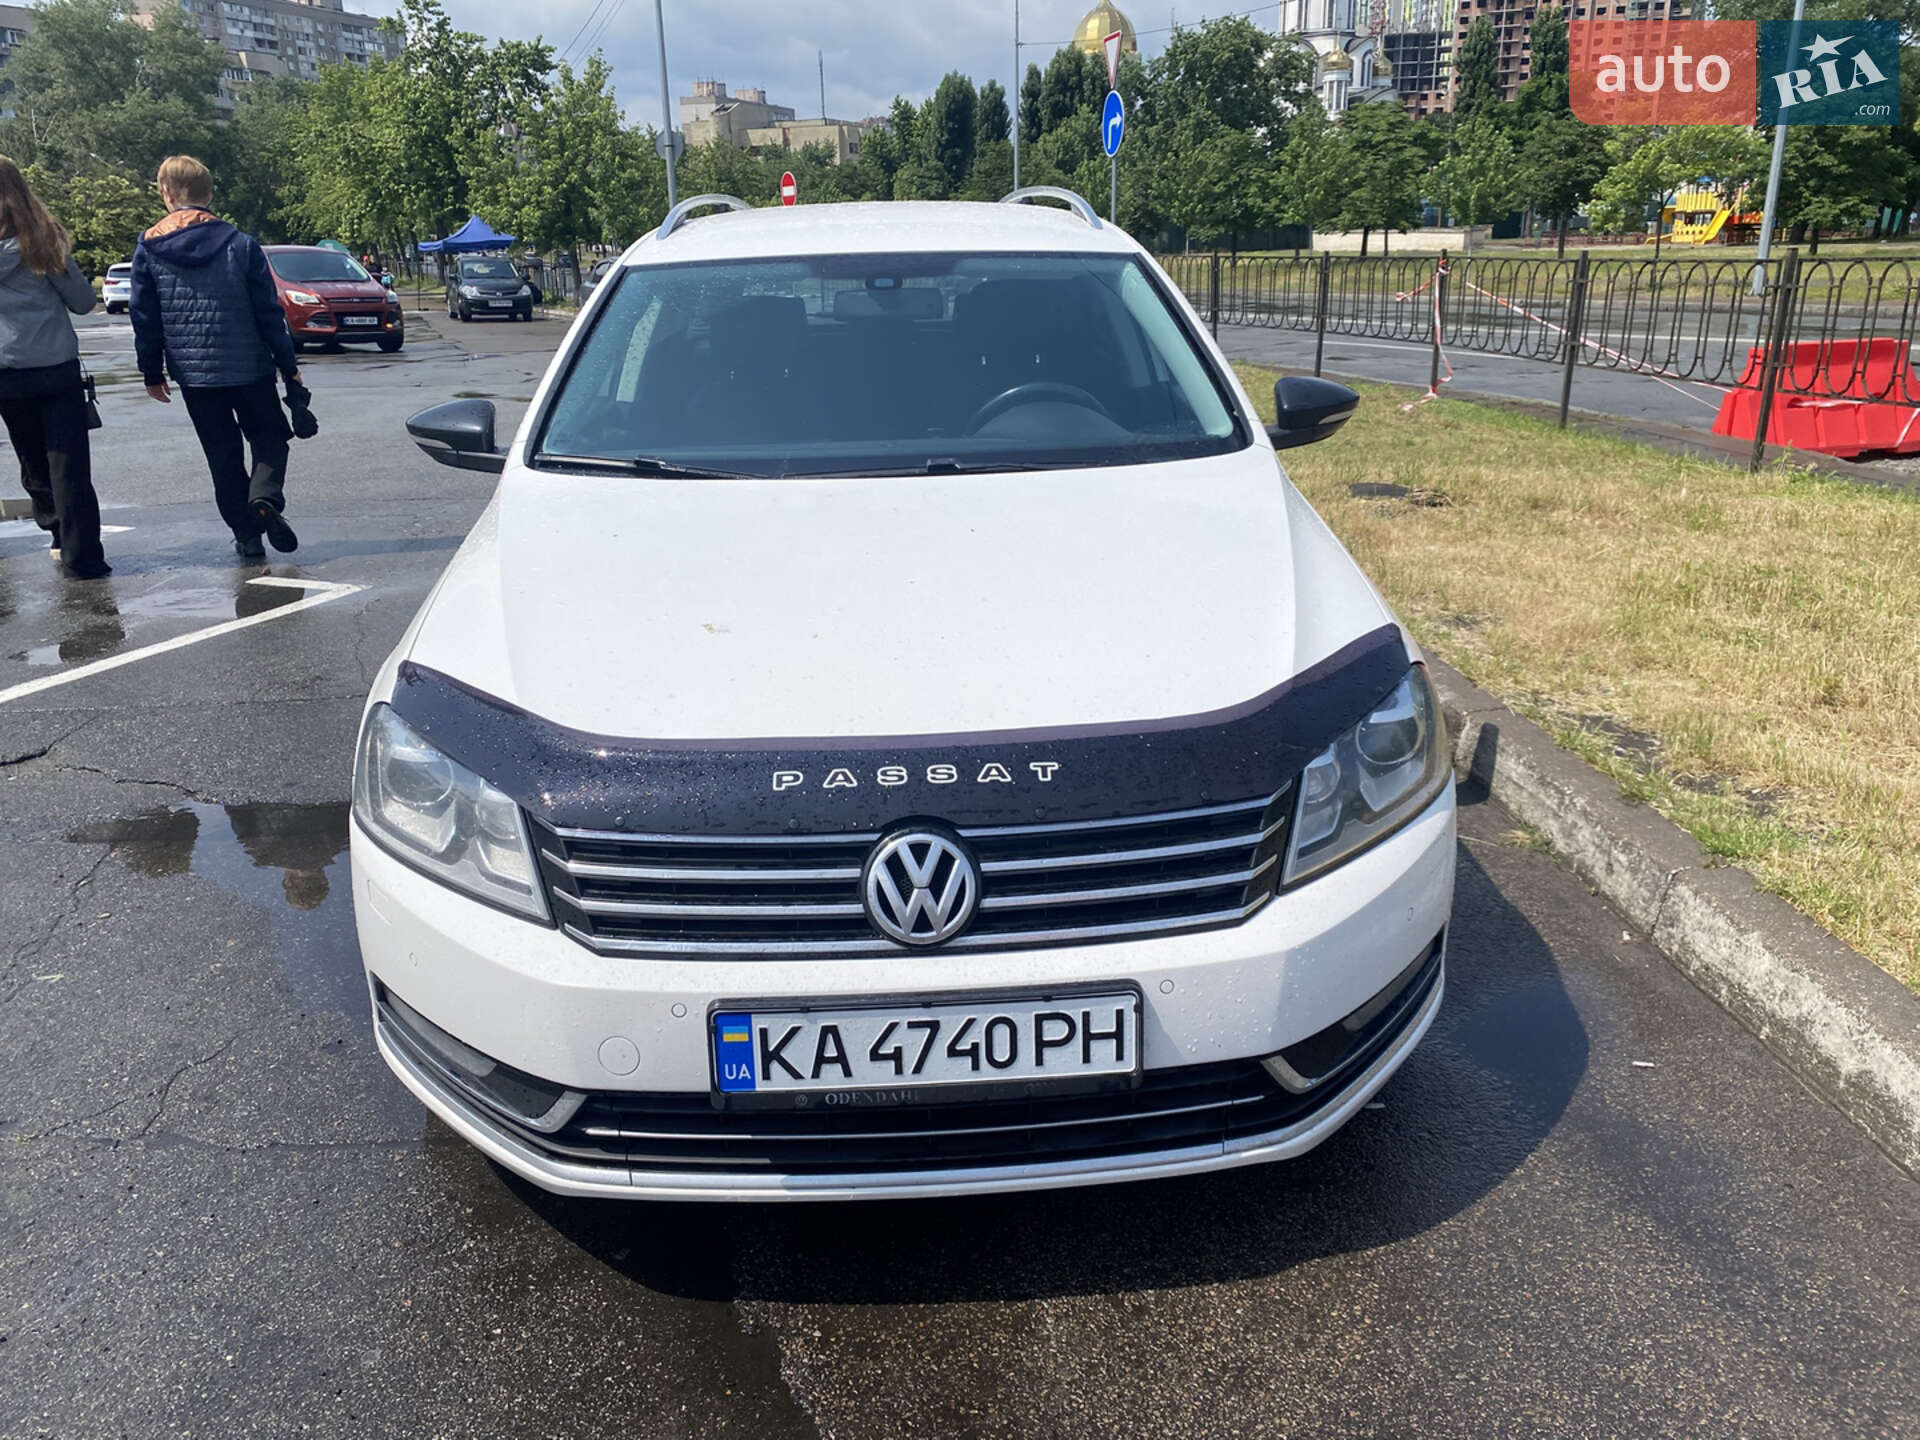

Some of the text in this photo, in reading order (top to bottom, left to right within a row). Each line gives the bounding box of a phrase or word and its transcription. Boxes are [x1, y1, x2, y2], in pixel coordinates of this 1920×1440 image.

[772, 761, 1061, 791] PASSAT
[758, 1007, 1126, 1081] KA 4740 PH
[725, 1063, 752, 1081] UA
